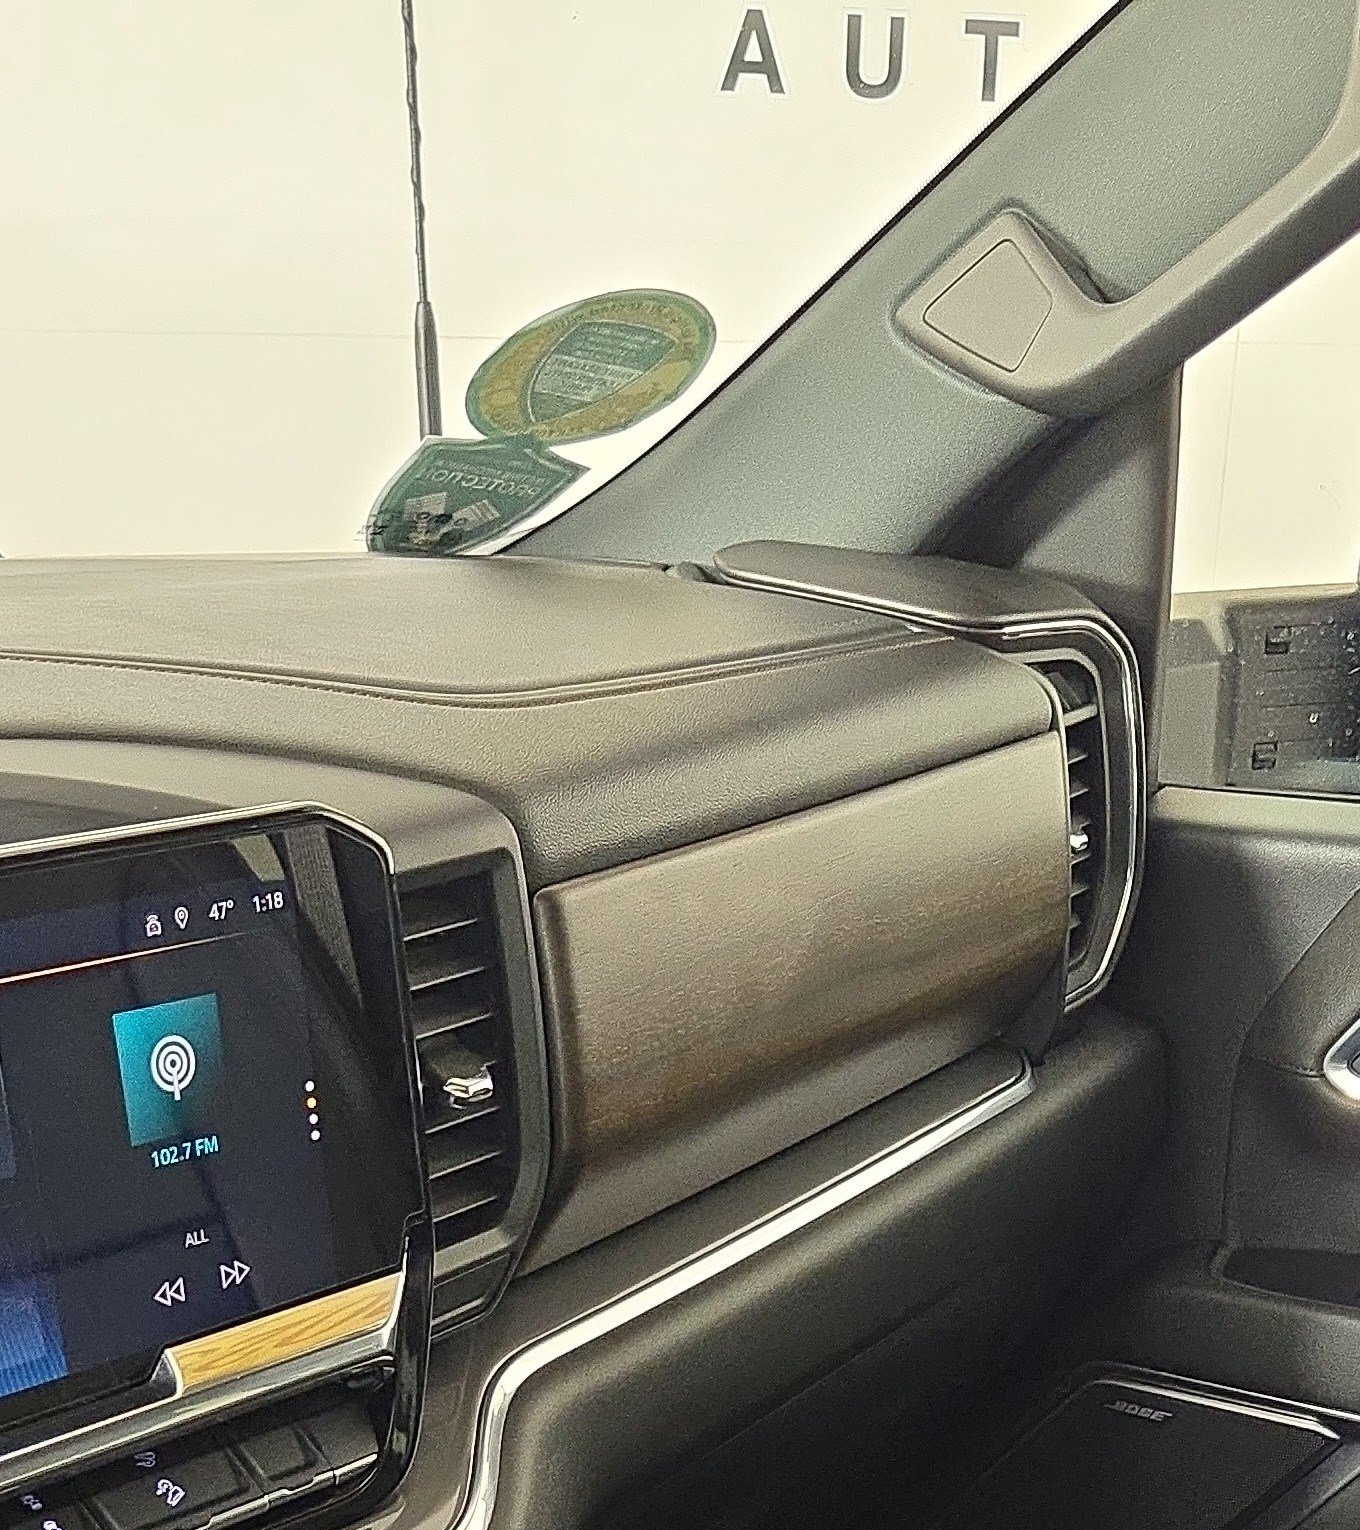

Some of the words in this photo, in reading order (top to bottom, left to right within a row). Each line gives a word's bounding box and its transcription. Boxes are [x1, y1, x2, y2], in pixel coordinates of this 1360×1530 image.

[252, 891, 284, 913] 1:18
[151, 1142, 191, 1168] 102.7
[195, 1135, 219, 1157] FM
[185, 1229, 210, 1249] ALL
